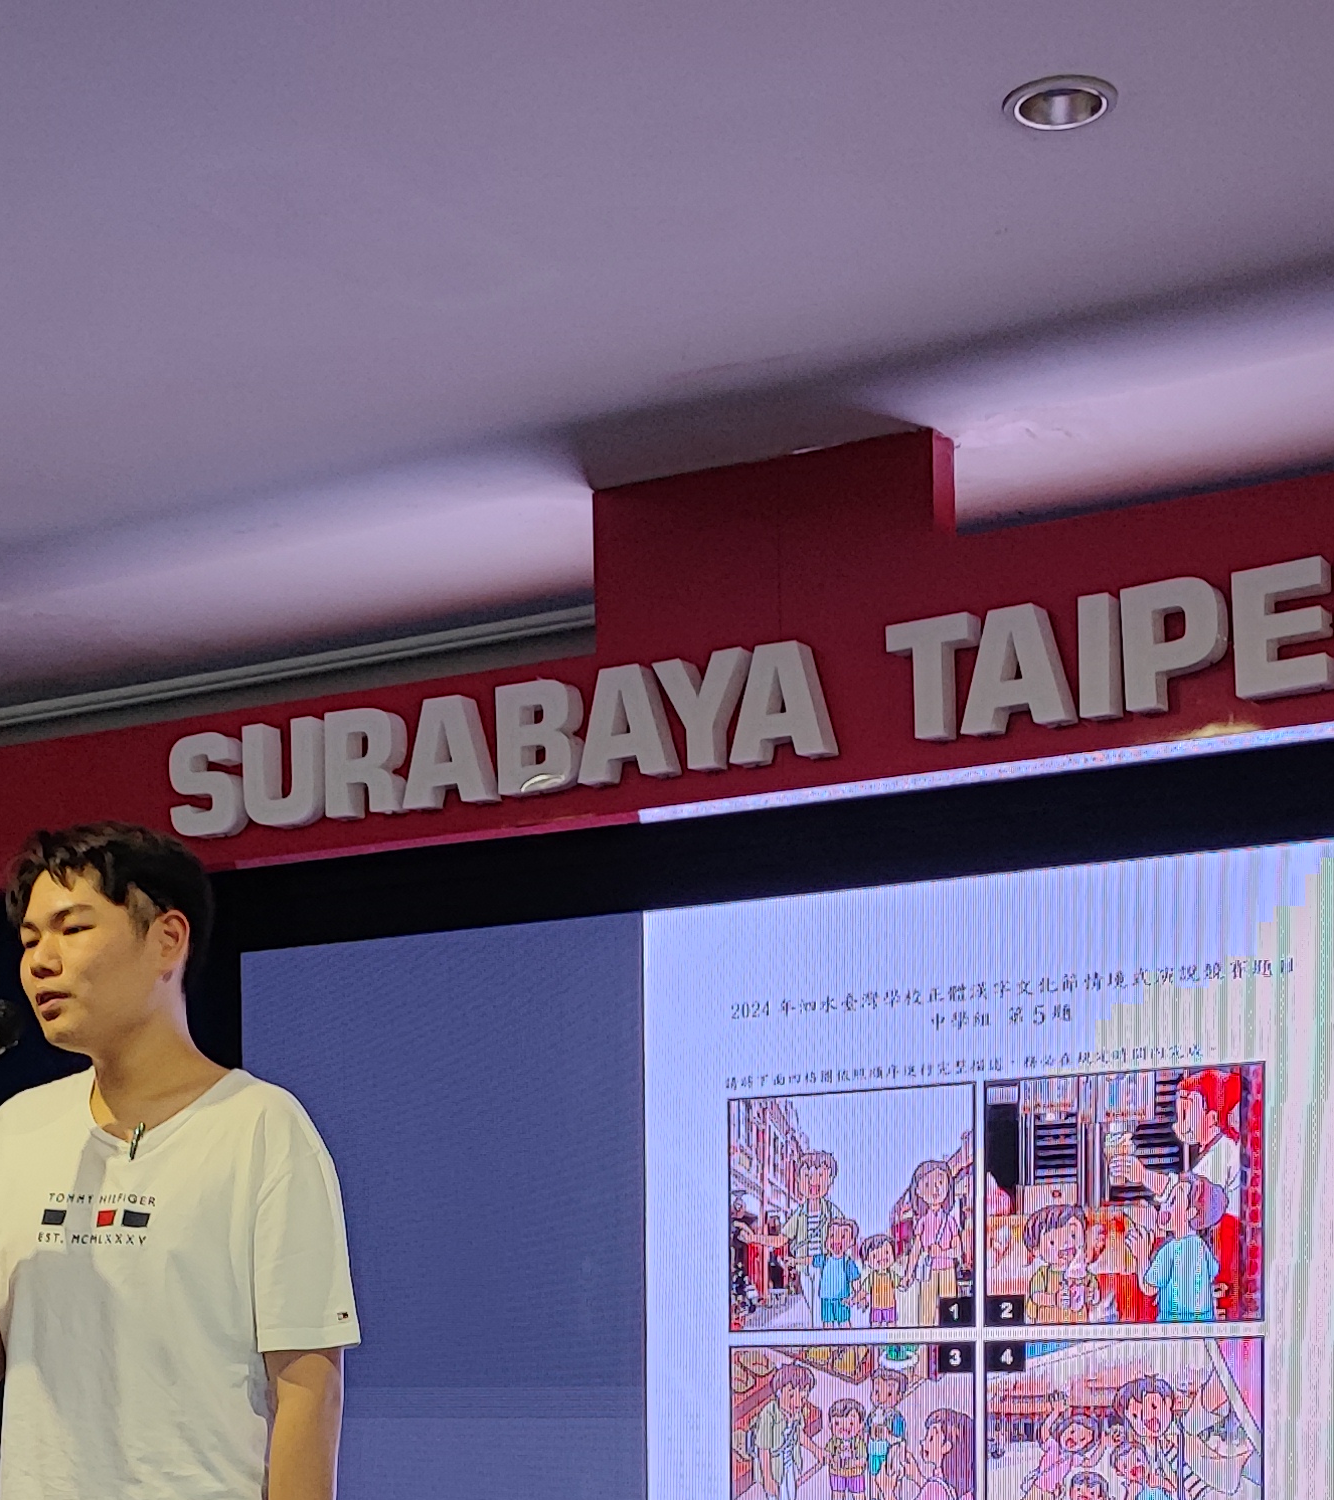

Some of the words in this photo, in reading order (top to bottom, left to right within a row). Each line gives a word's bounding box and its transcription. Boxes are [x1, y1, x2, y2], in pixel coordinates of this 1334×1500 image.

[170, 641, 839, 839] SURABAYA
[731, 1000, 770, 1020] 2024
[49, 1193, 94, 1204] TOMMY
[99, 1193, 156, 1207] HILFIGER
[37, 1232, 64, 1244] EST.
[71, 1233, 147, 1246] MCMLXXXV
[948, 1303, 959, 1320] 1
[1000, 1302, 1013, 1319] 2
[949, 1348, 962, 1366] 3
[1000, 1347, 1013, 1365] 4
